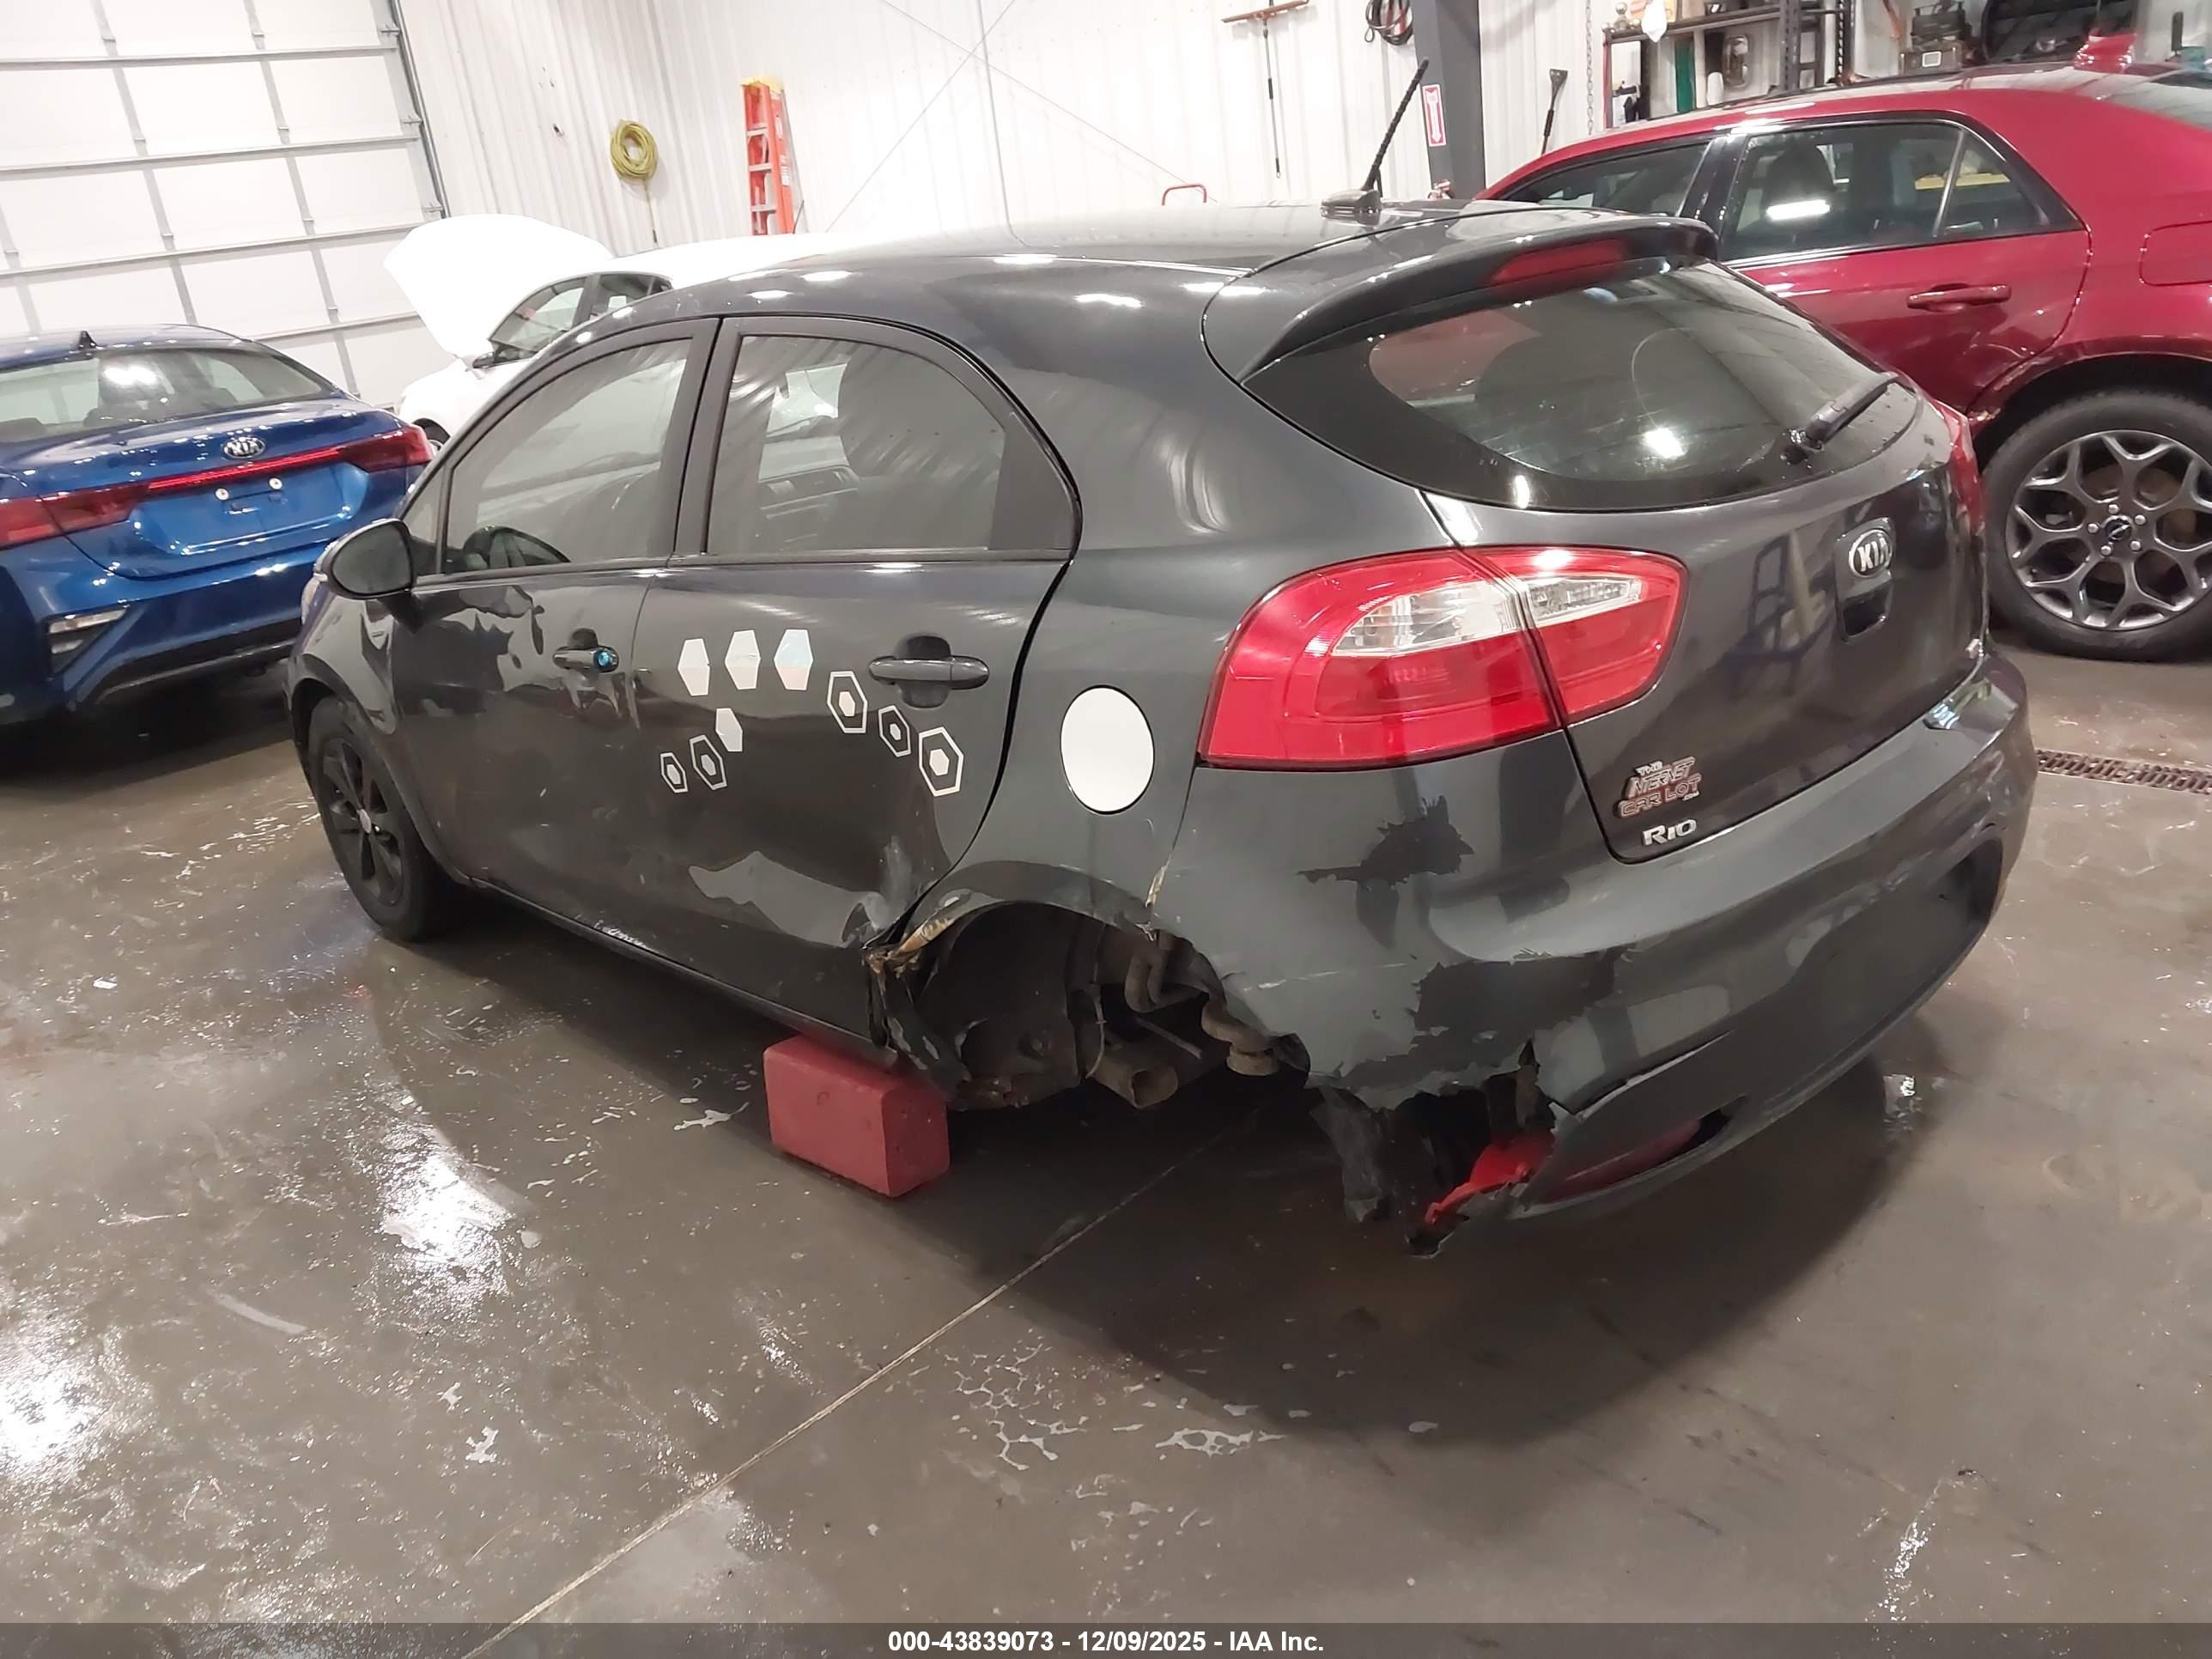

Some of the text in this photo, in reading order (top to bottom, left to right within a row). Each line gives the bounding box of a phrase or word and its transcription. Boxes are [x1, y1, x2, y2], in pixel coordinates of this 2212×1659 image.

[226, 436, 261, 457] KIA
[1855, 536, 1890, 573] KIA
[1618, 773, 1702, 818] CAR LOT
